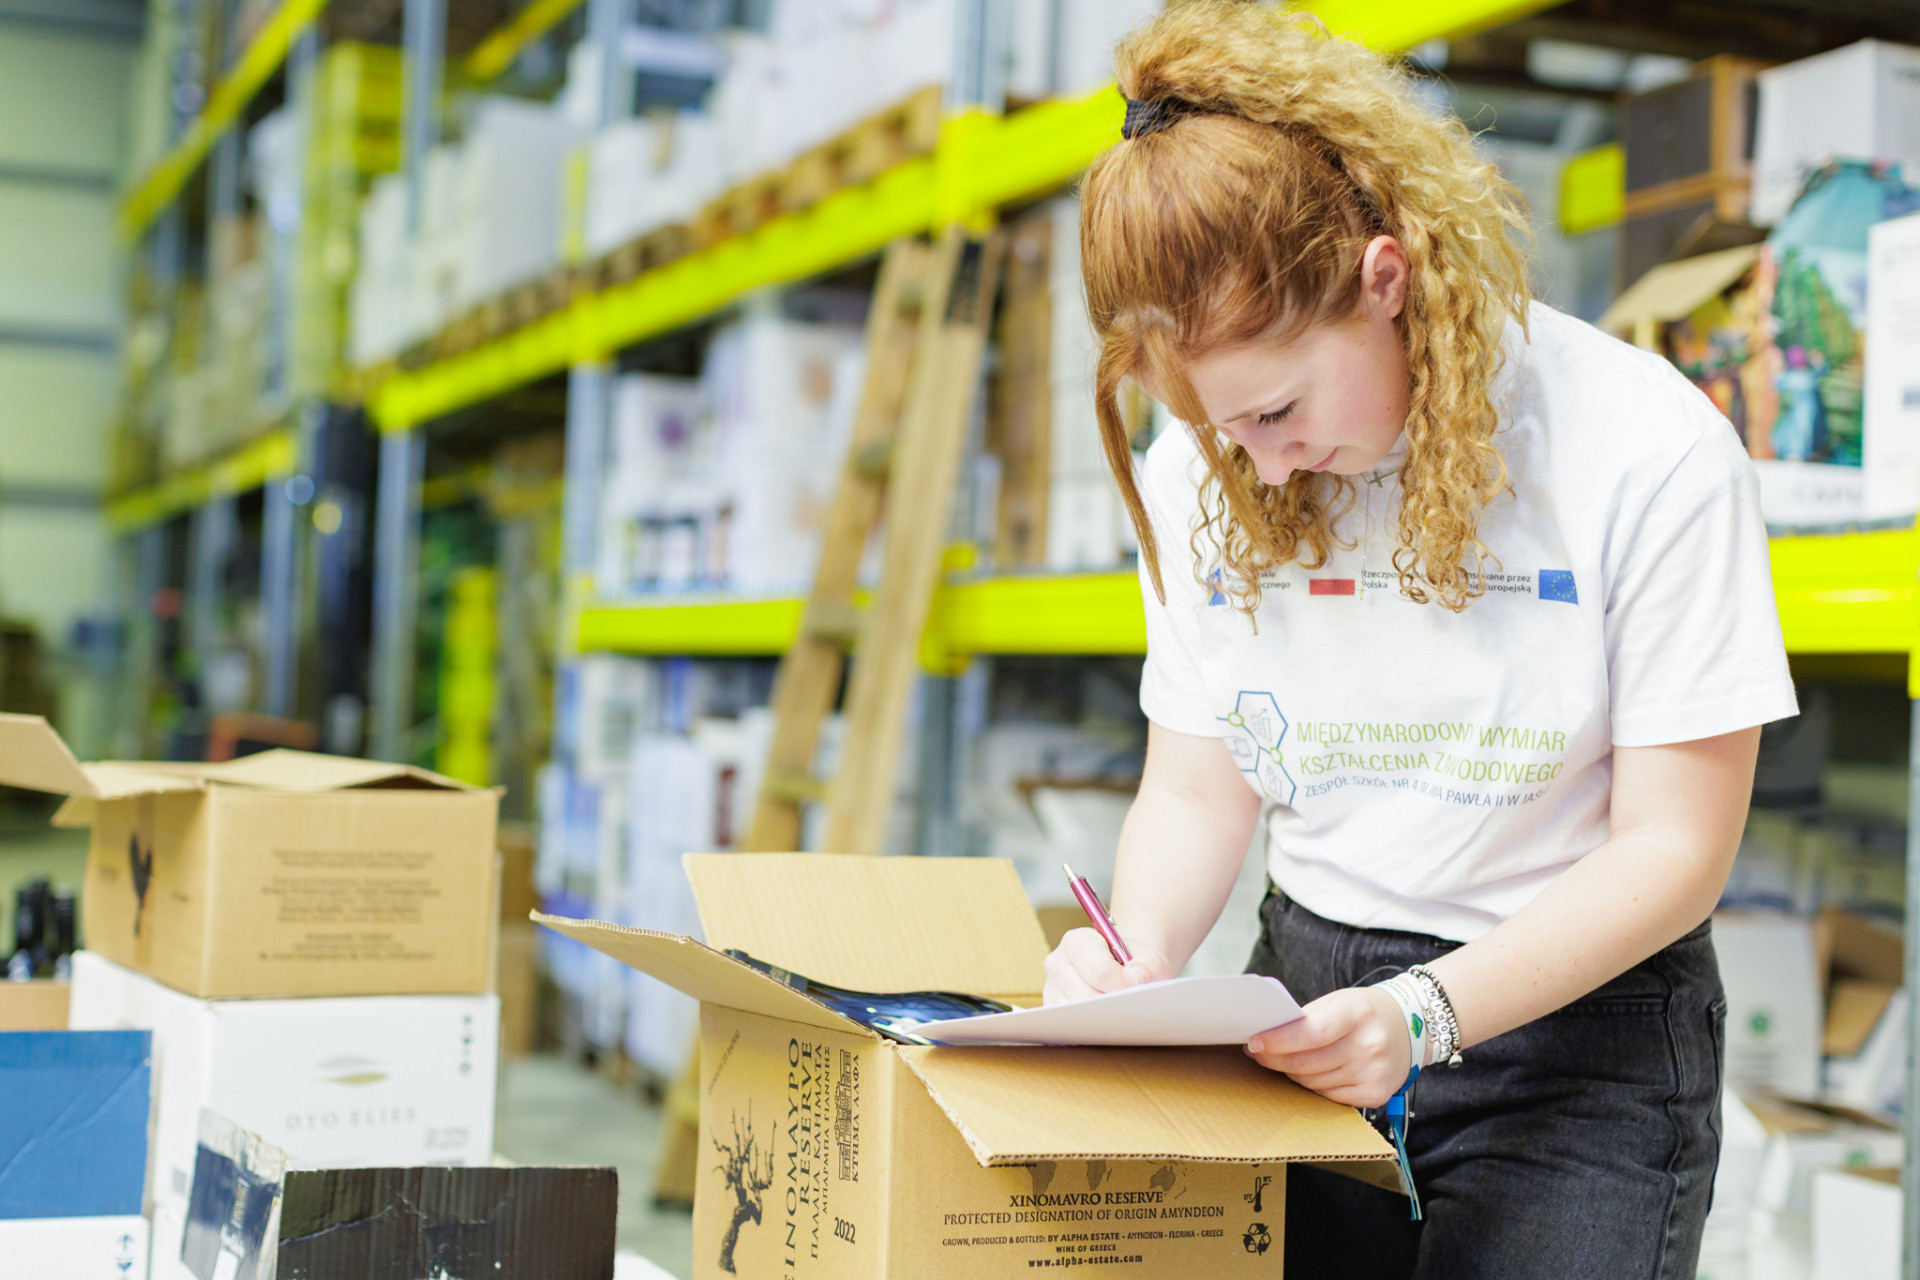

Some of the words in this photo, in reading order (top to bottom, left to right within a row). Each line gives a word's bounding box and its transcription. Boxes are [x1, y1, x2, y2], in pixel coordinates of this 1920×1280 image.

[1507, 574, 1531, 583] przez
[1479, 726, 1566, 752] WYMIAR
[1299, 752, 1430, 776] KSZTAŁCENIA
[1392, 778, 1409, 790] NR
[1446, 789, 1492, 807] PAWŁA
[1507, 794, 1520, 806] W
[799, 1041, 813, 1207] RESERVE
[1009, 1192, 1102, 1208] XINOMAVRO
[1105, 1191, 1164, 1205] RESERVE
[943, 1212, 1012, 1225] PROTECTED
[1015, 1209, 1093, 1223] DESIGNATION
[1097, 1208, 1112, 1221] OF
[1115, 1207, 1157, 1220] ORIGIN
[1160, 1206, 1224, 1219] AMYNDEON
[833, 1216, 856, 1245] 2022
[942, 1237, 971, 1247] GROWN,
[972, 1235, 1008, 1245] PRODUCED
[1009, 1236, 1014, 1244] &
[1015, 1234, 1046, 1244] BOTTLED:
[1048, 1234, 1059, 1242] BY
[1061, 1233, 1089, 1241] ALPHA
[1091, 1232, 1120, 1241] ESTATE
[1127, 1231, 1163, 1240] AMYNDEON
[1169, 1230, 1196, 1239] FLORINA
[1201, 1229, 1224, 1238] GREECE
[1055, 1245, 1075, 1253] WINE
[1089, 1244, 1117, 1252] GREECE
[1028, 1254, 1143, 1268] www.alpha-estate.com
